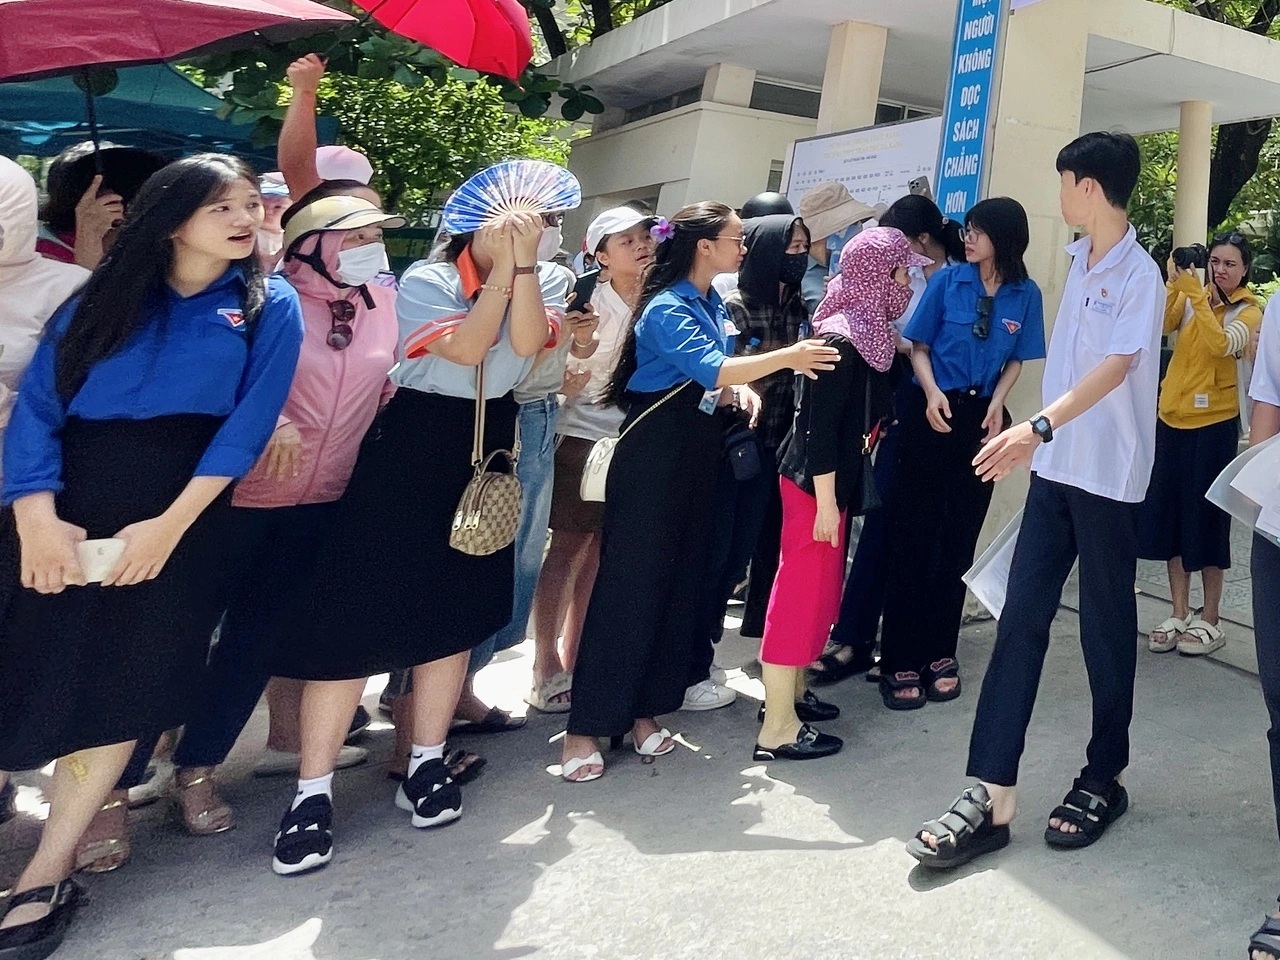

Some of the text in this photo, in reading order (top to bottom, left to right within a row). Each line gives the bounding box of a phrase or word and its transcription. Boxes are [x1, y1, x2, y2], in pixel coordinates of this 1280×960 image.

[964, 11, 995, 40] NGƯỜI
[958, 47, 992, 74] KHÔNG
[960, 84, 981, 110] ĐỌC
[953, 117, 979, 142] SÁCH
[945, 190, 967, 213] HƠN
